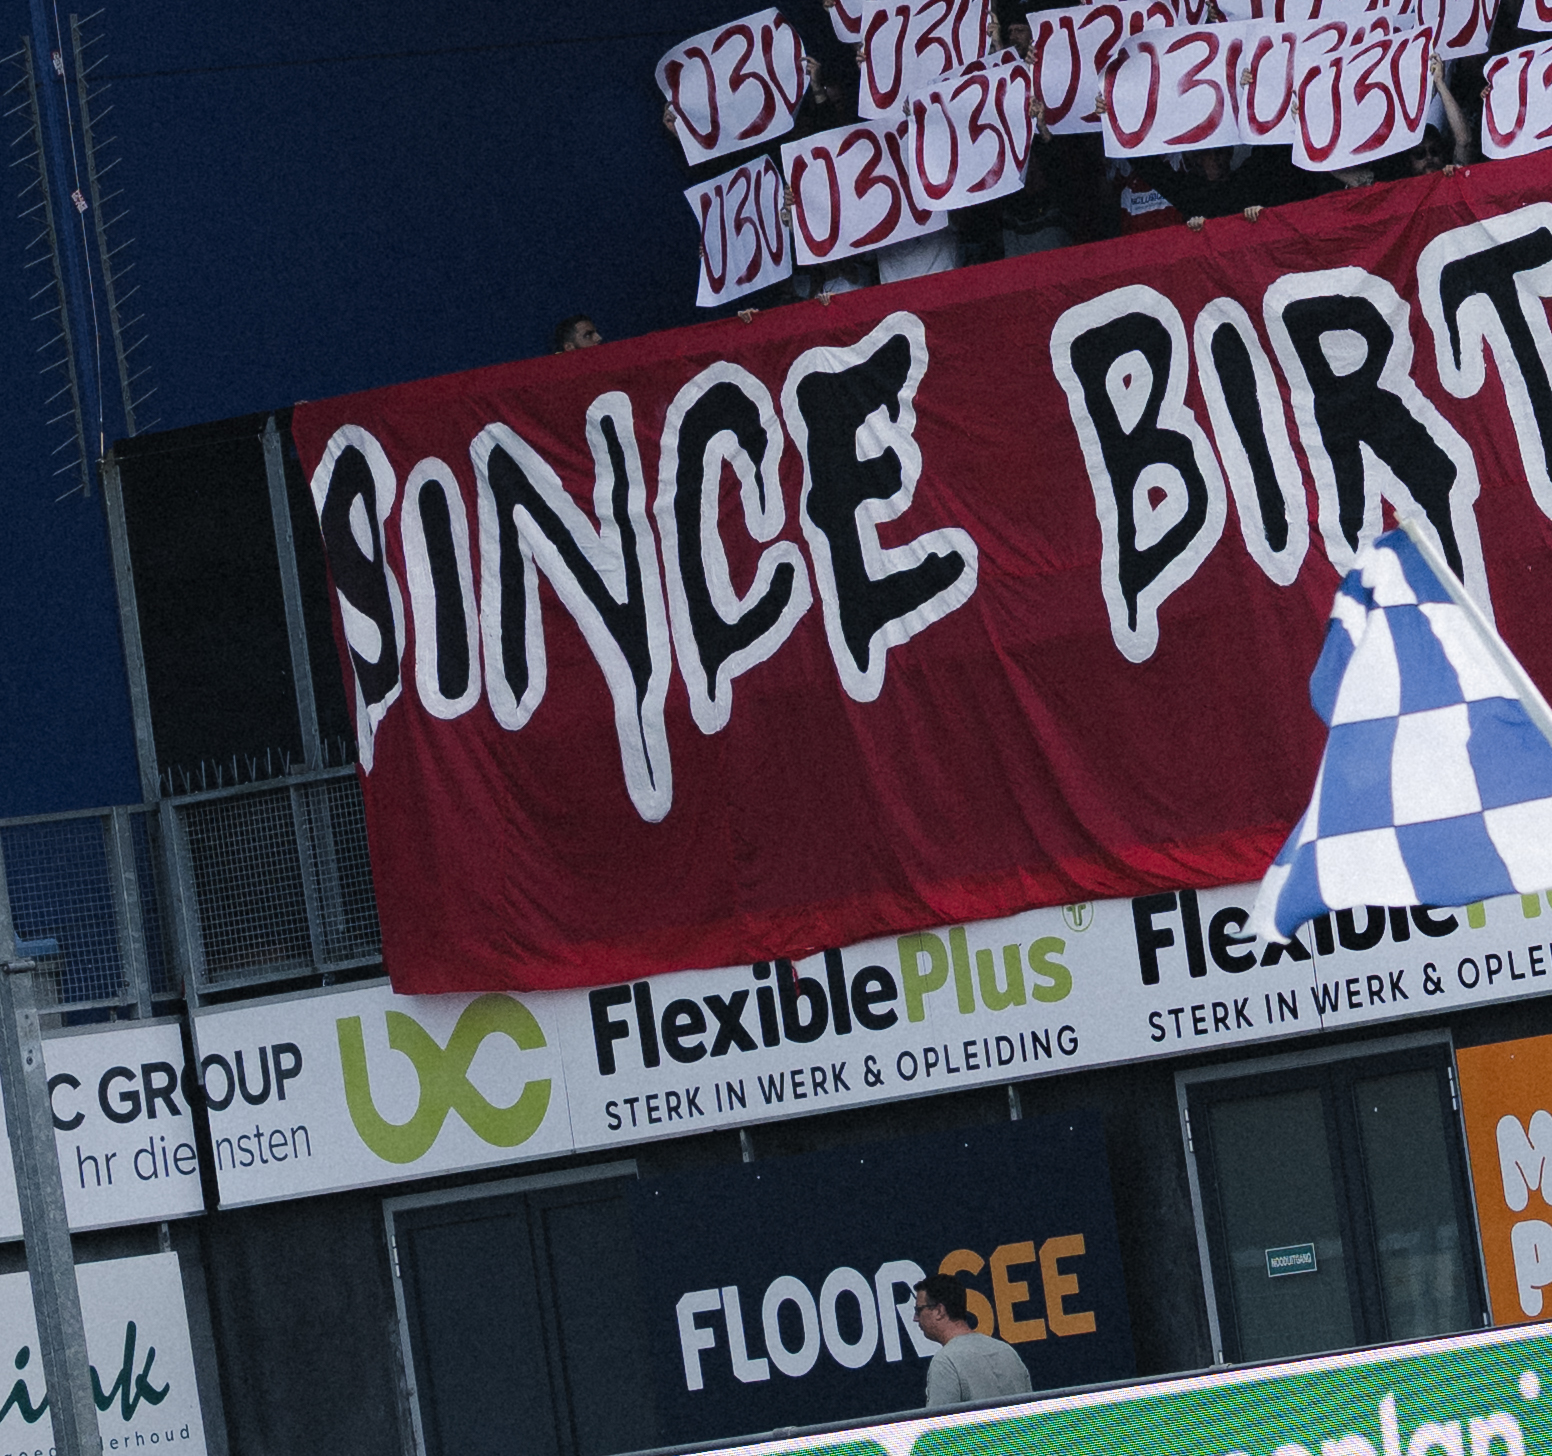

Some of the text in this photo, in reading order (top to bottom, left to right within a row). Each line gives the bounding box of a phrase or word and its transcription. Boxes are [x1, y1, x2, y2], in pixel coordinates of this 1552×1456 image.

[310, 310, 979, 823] SINCE
[1148, 999, 1253, 1042] STERK
[1265, 990, 1299, 1023] IN
[1310, 969, 1410, 1016] WERK
[1422, 962, 1444, 994] &
[98, 1042, 303, 1124] GROUP
[605, 1024, 1080, 1131] STERK IN WERK & OPLEIDING
